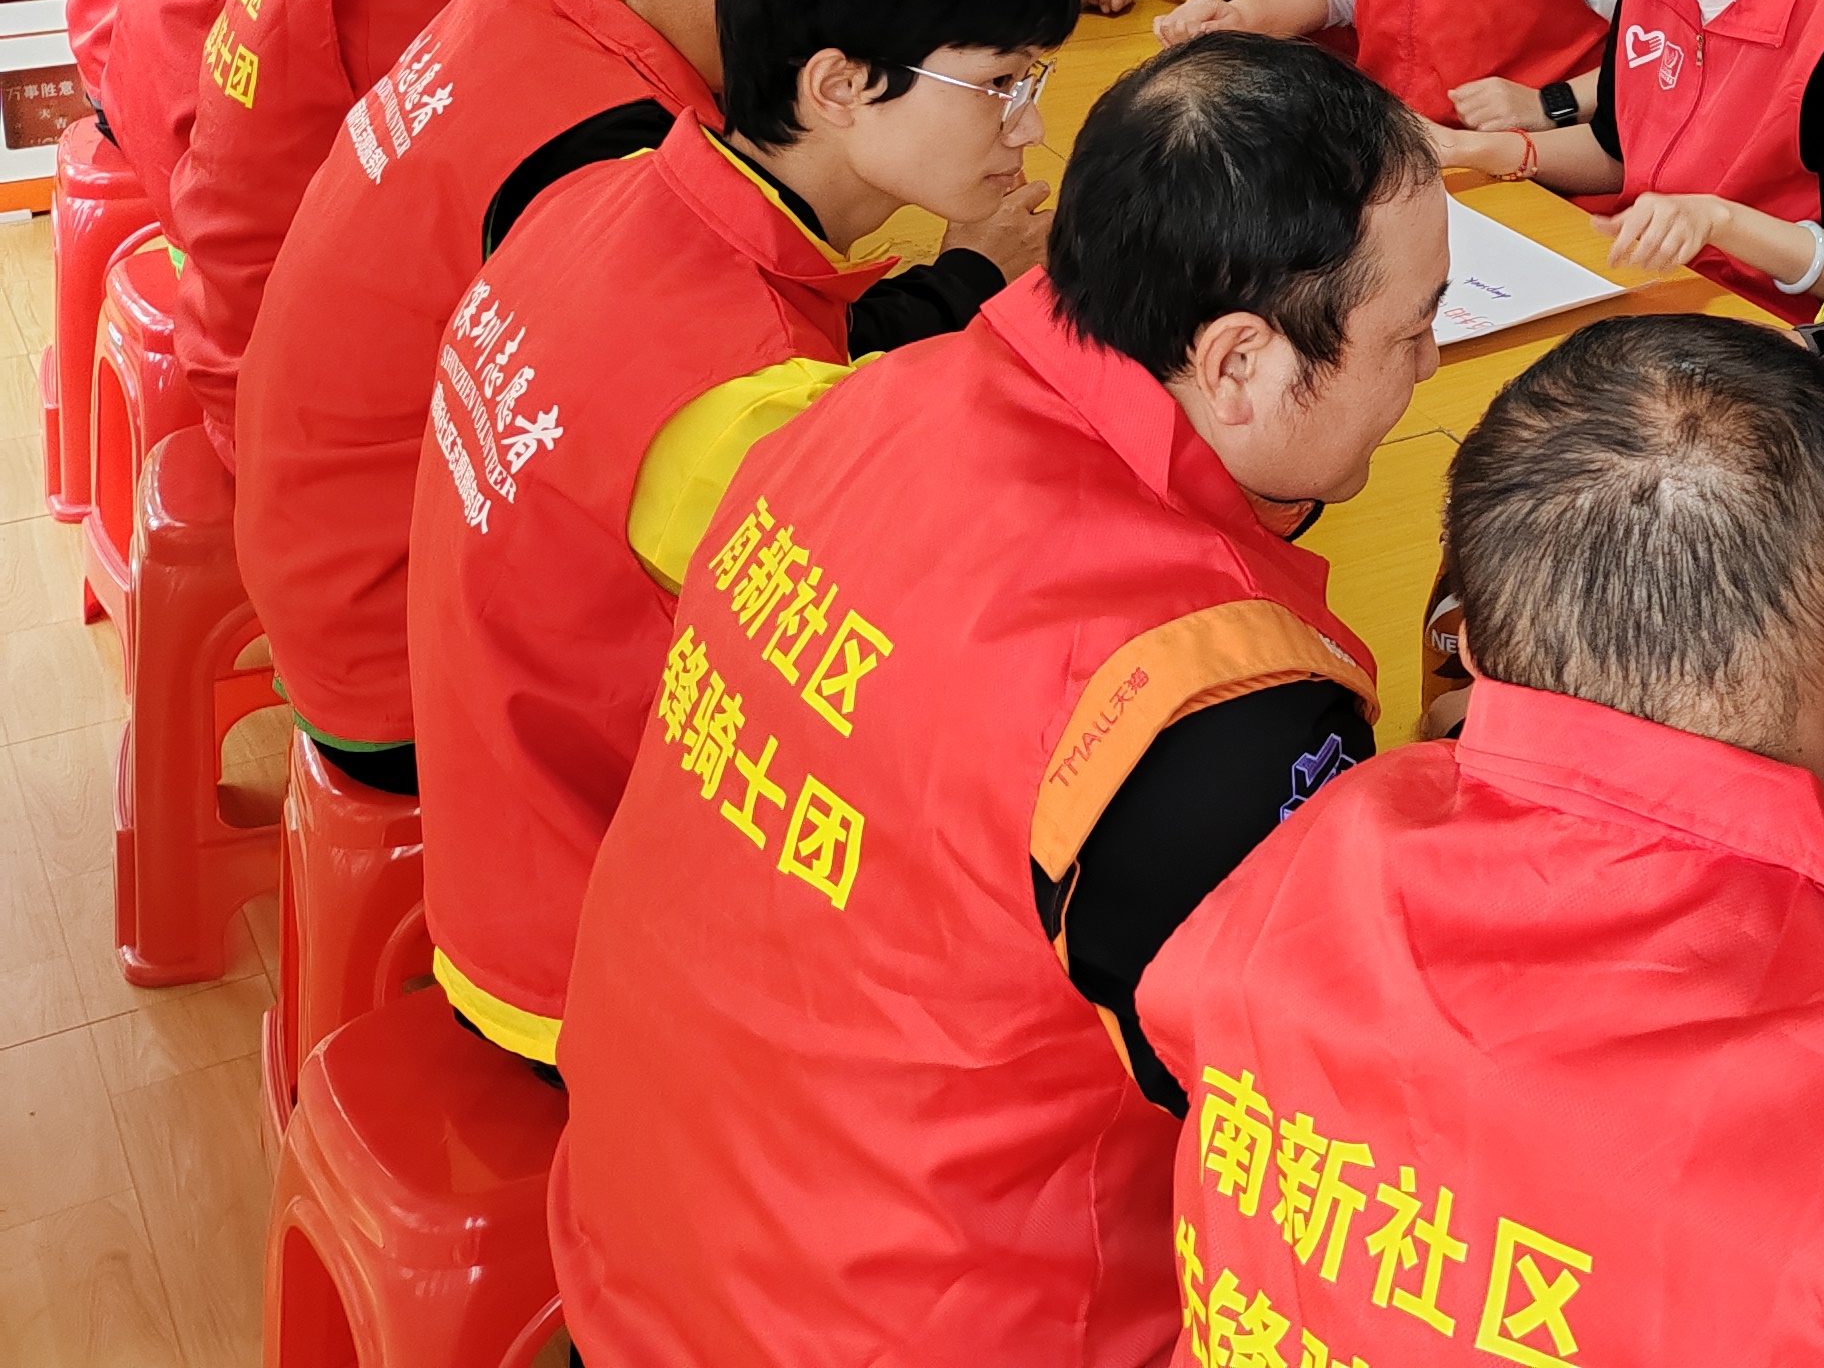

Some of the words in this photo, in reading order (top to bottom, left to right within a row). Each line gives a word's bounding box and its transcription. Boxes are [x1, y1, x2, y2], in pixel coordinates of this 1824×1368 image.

[453, 279, 564, 475] 深圳志愿者
[708, 494, 894, 738] 南新社区
[1200, 1065, 1593, 1368] 南新社区
